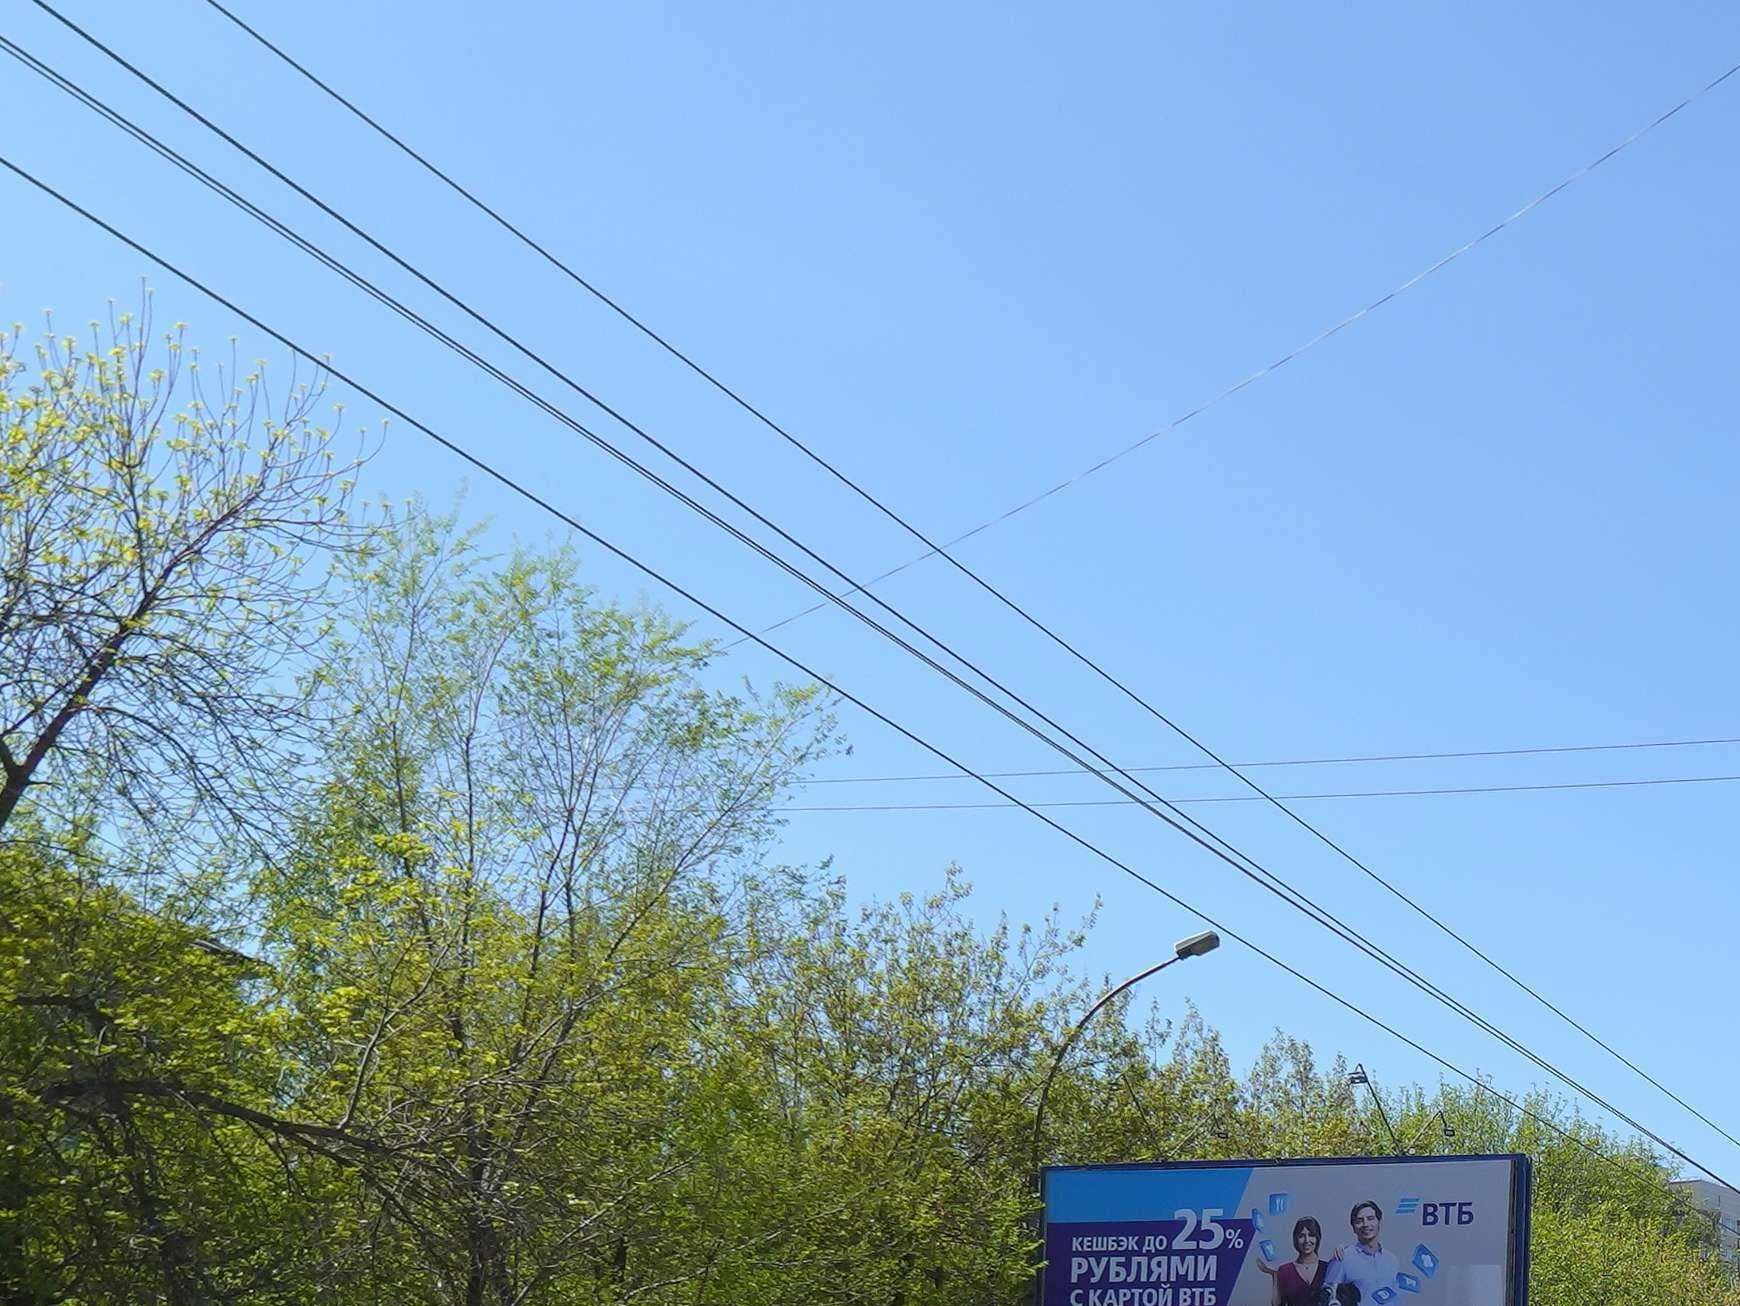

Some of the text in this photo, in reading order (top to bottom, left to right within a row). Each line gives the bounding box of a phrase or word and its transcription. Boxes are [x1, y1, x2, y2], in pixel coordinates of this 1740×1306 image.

[1423, 1202, 1474, 1226] ВТБ
[1072, 1208, 1244, 1253] КЕШБЭК ДО 25%
[1071, 1255, 1216, 1283] РУБЛЯМИ
[1178, 1287, 1217, 1306] ВТБ
